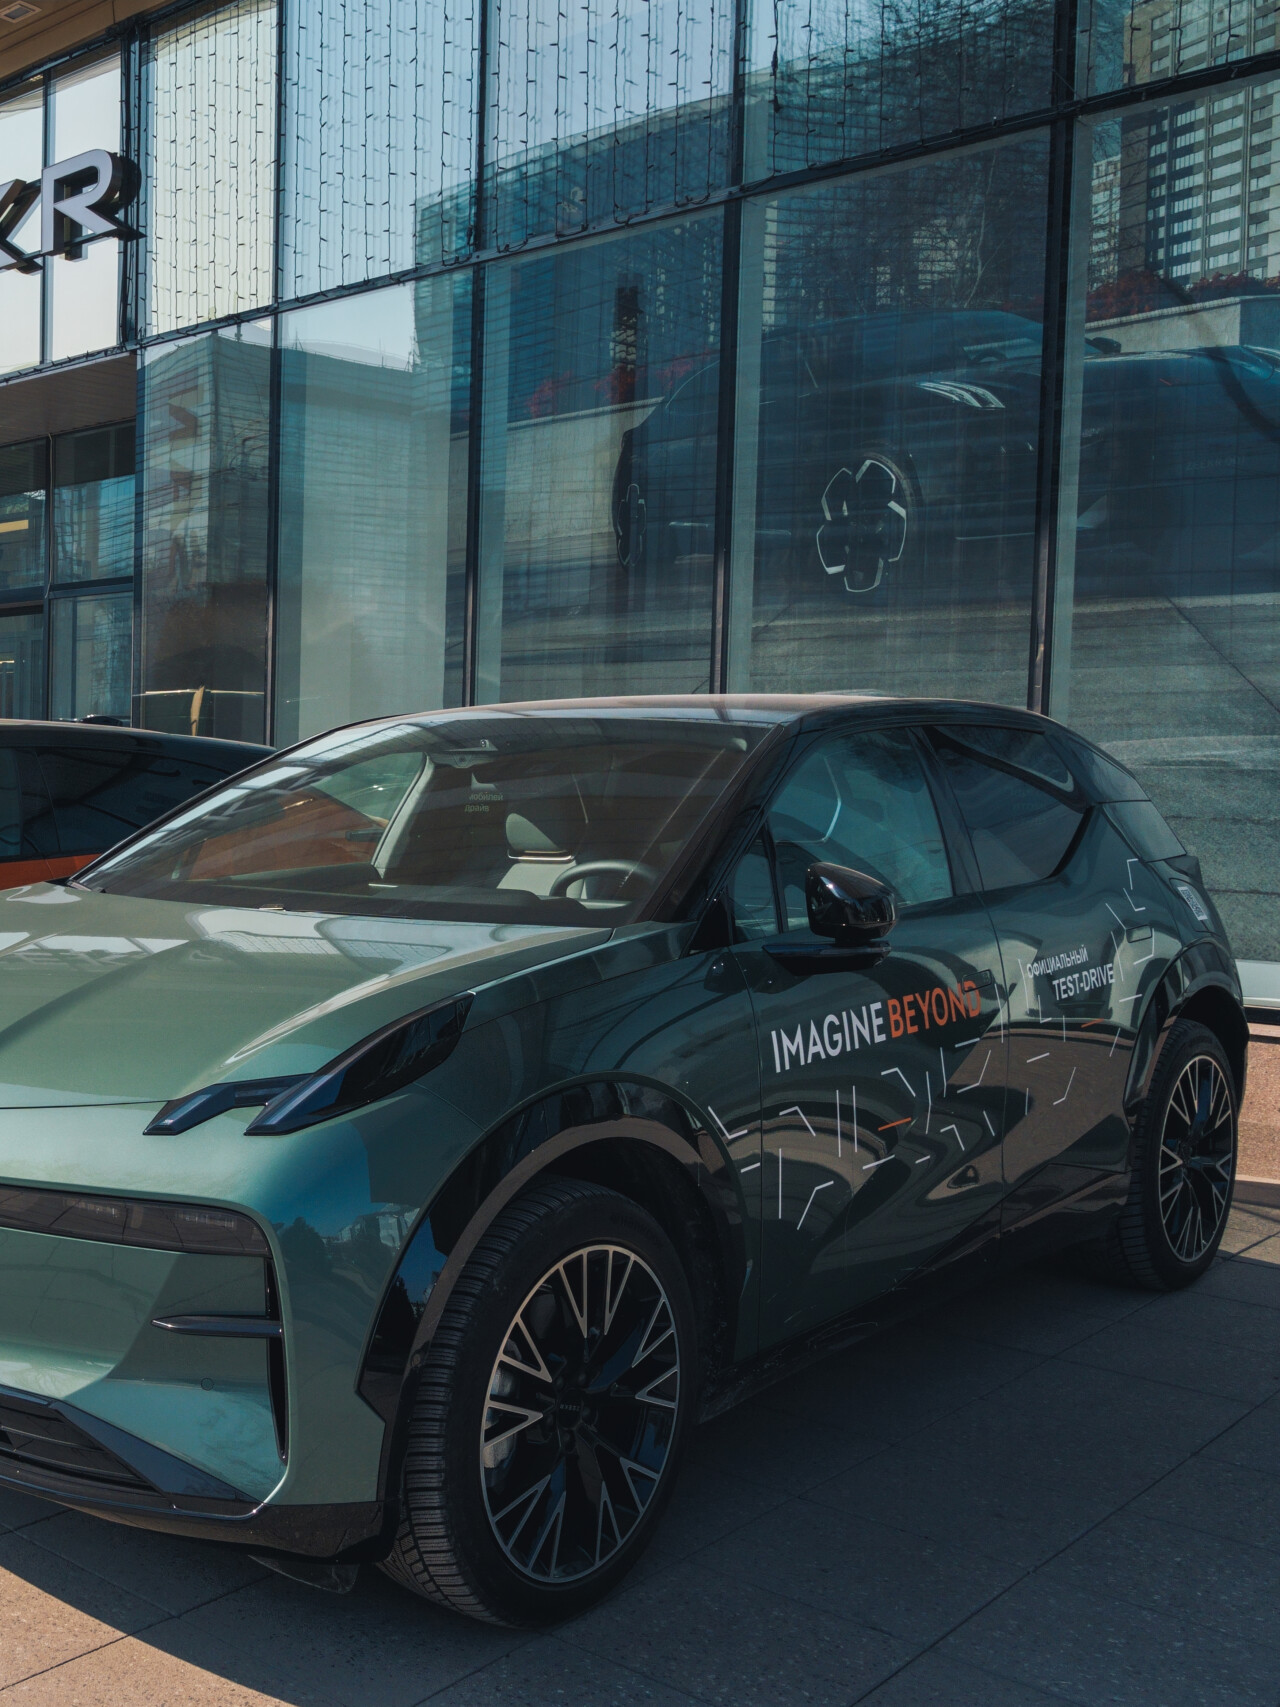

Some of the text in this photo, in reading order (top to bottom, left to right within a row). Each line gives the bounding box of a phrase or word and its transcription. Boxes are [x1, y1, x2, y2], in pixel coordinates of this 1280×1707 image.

[1026, 944, 1089, 979] ОФИЦИАЛЬНЫЙ
[1052, 963, 1116, 1001] TEST-DRIVE
[770, 979, 982, 1073] IMAGINE BEYOND
